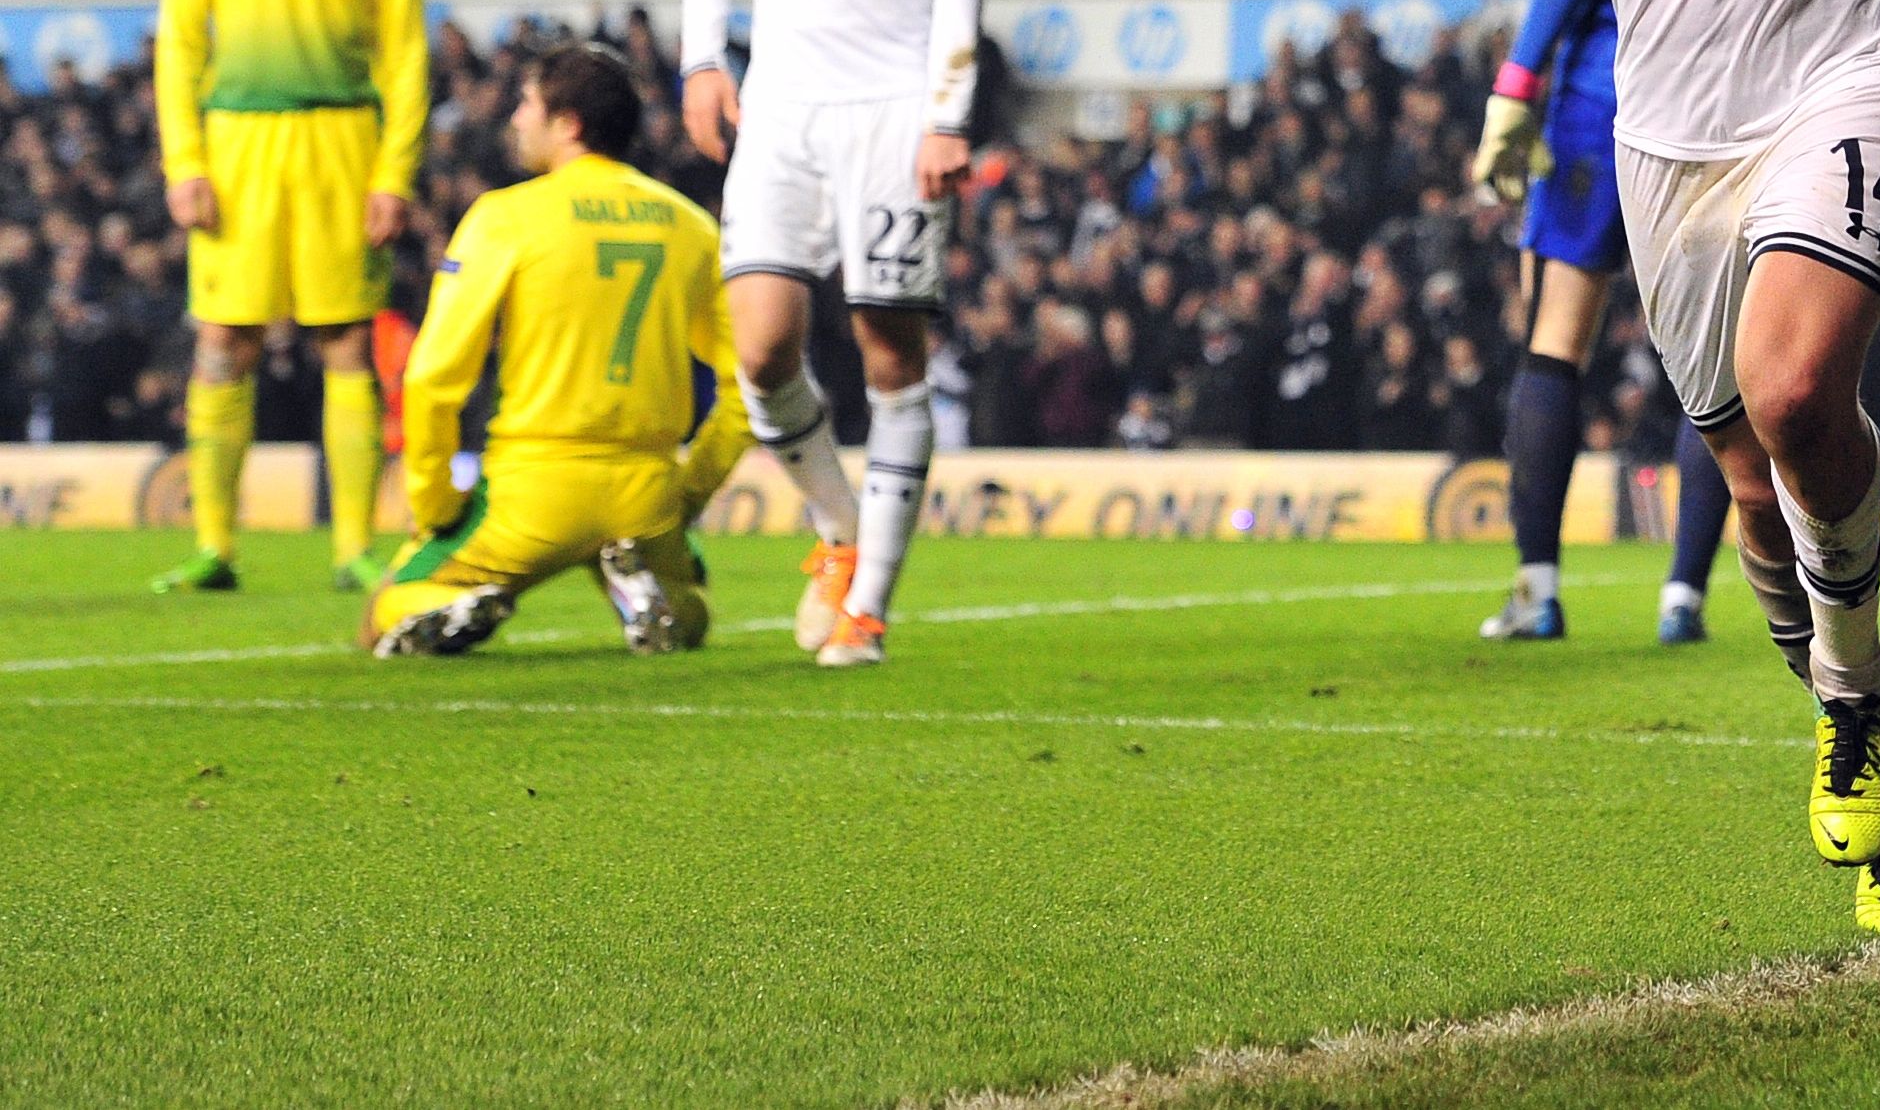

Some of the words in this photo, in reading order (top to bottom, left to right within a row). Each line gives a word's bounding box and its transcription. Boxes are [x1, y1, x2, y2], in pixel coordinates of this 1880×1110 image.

[866, 205, 928, 265] 22
[596, 241, 665, 384] 7
[1092, 485, 1378, 540] ONLINE
